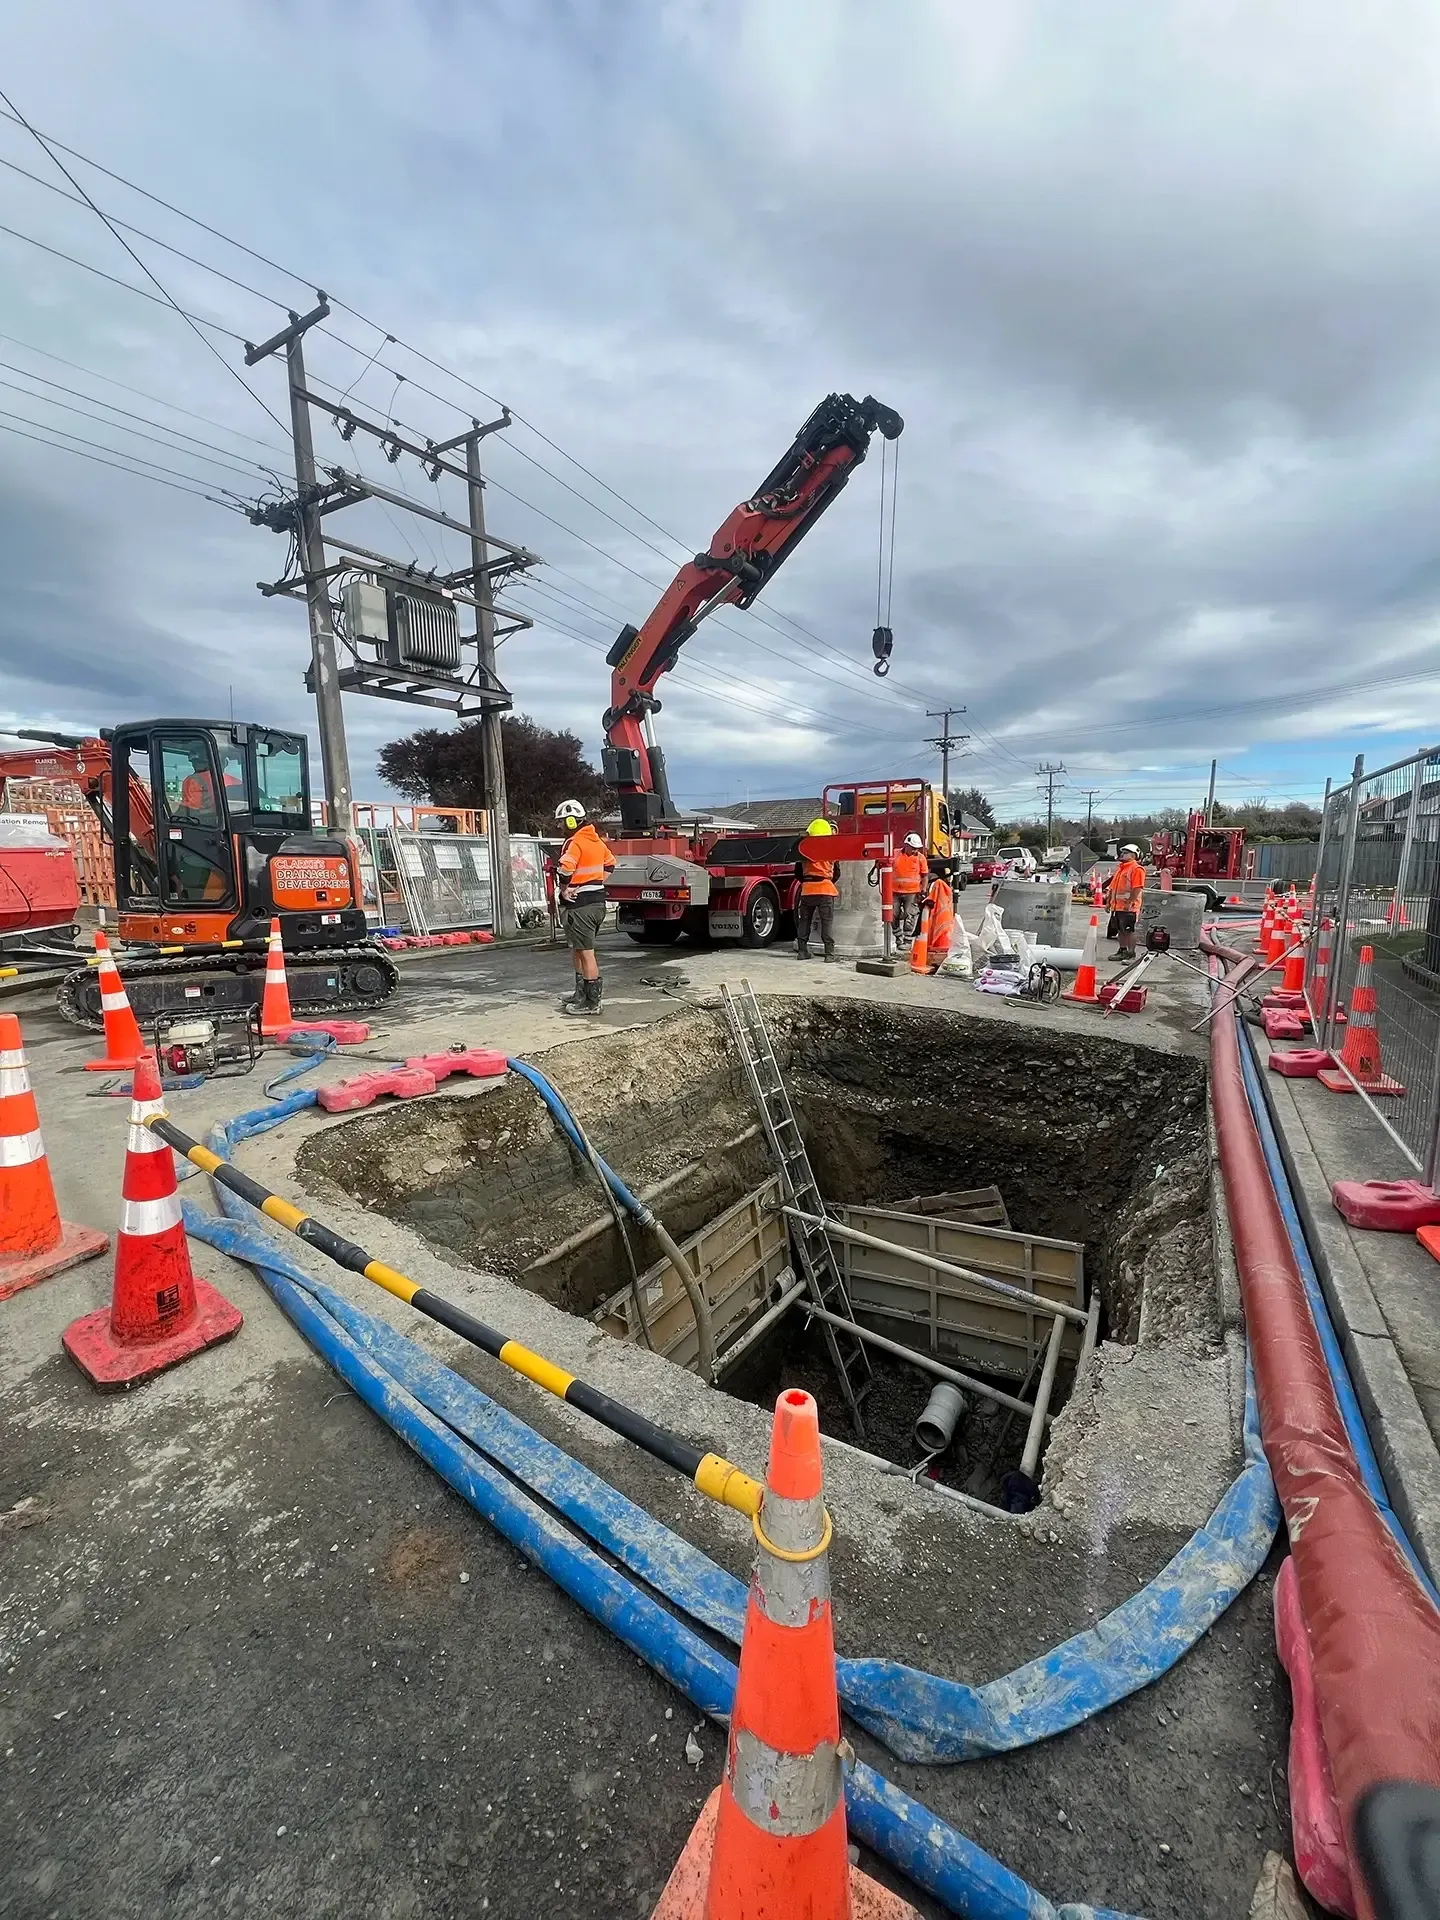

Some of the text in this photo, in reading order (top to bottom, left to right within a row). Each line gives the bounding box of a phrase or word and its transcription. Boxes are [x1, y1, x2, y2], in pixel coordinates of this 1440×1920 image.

[617, 637, 642, 673] PALFINGER
[275, 860, 325, 869] CLARKE'S
[277, 870, 329, 879] DRAINAGE
[278, 880, 350, 889] DEVELOPMENTS
